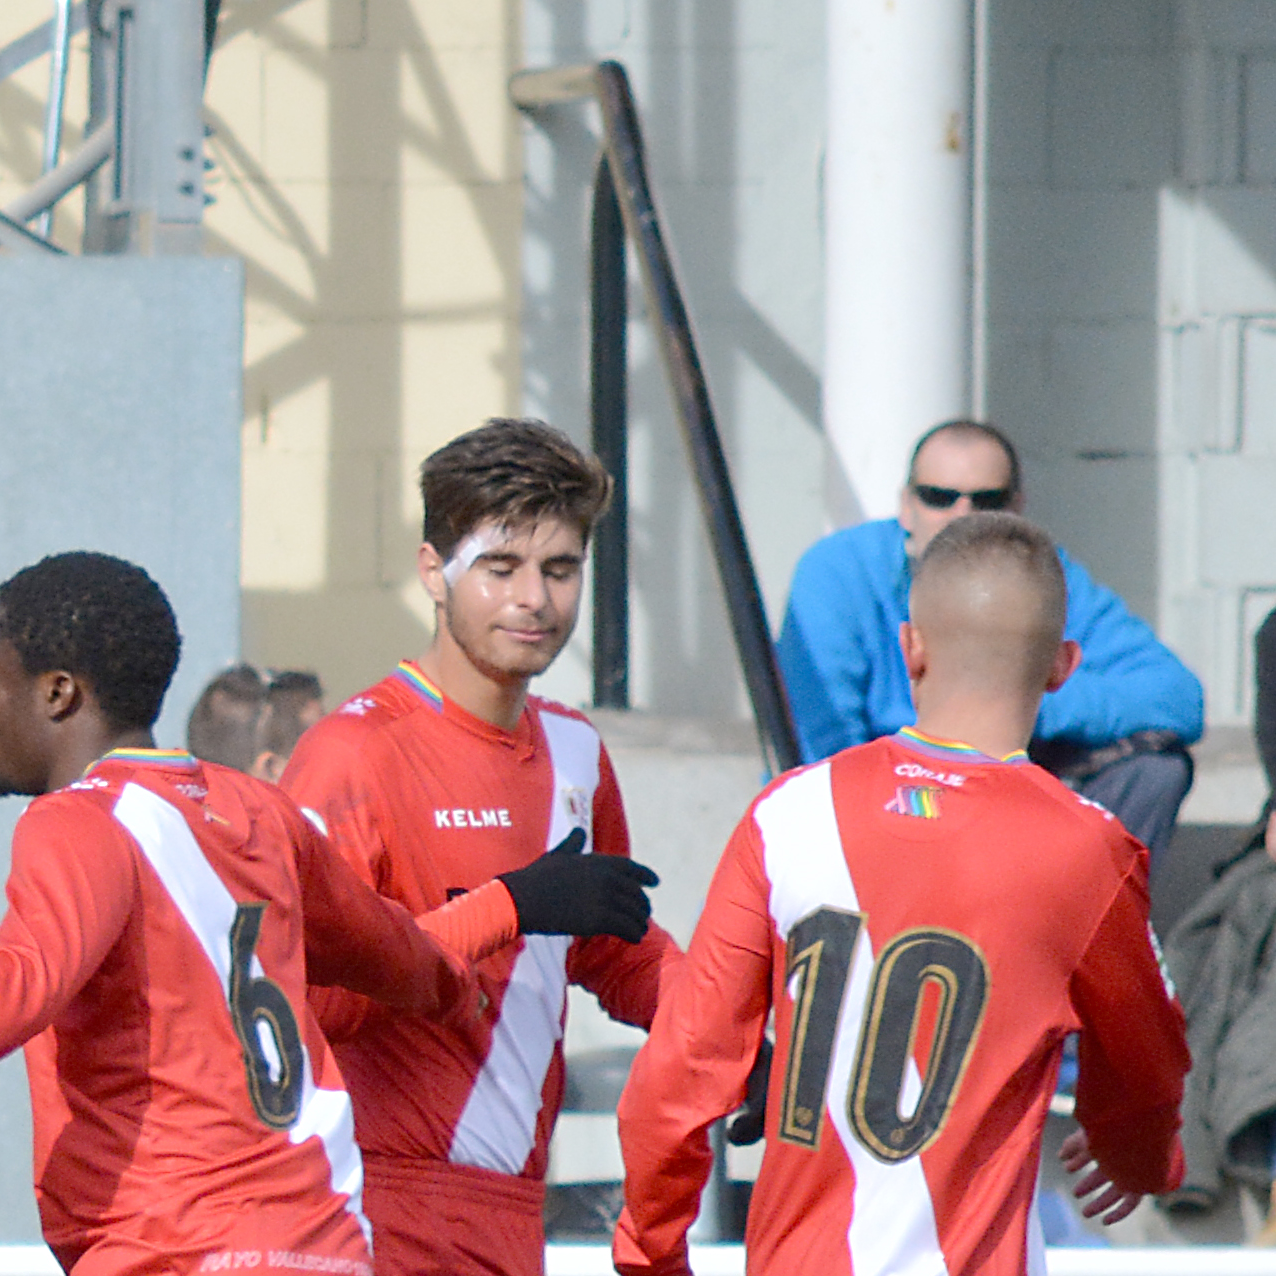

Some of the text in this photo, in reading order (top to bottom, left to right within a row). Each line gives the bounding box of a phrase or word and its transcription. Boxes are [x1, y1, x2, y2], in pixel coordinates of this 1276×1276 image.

[434, 809, 513, 828] KELME
[229, 900, 304, 1132] 6
[778, 903, 992, 1167] 10
